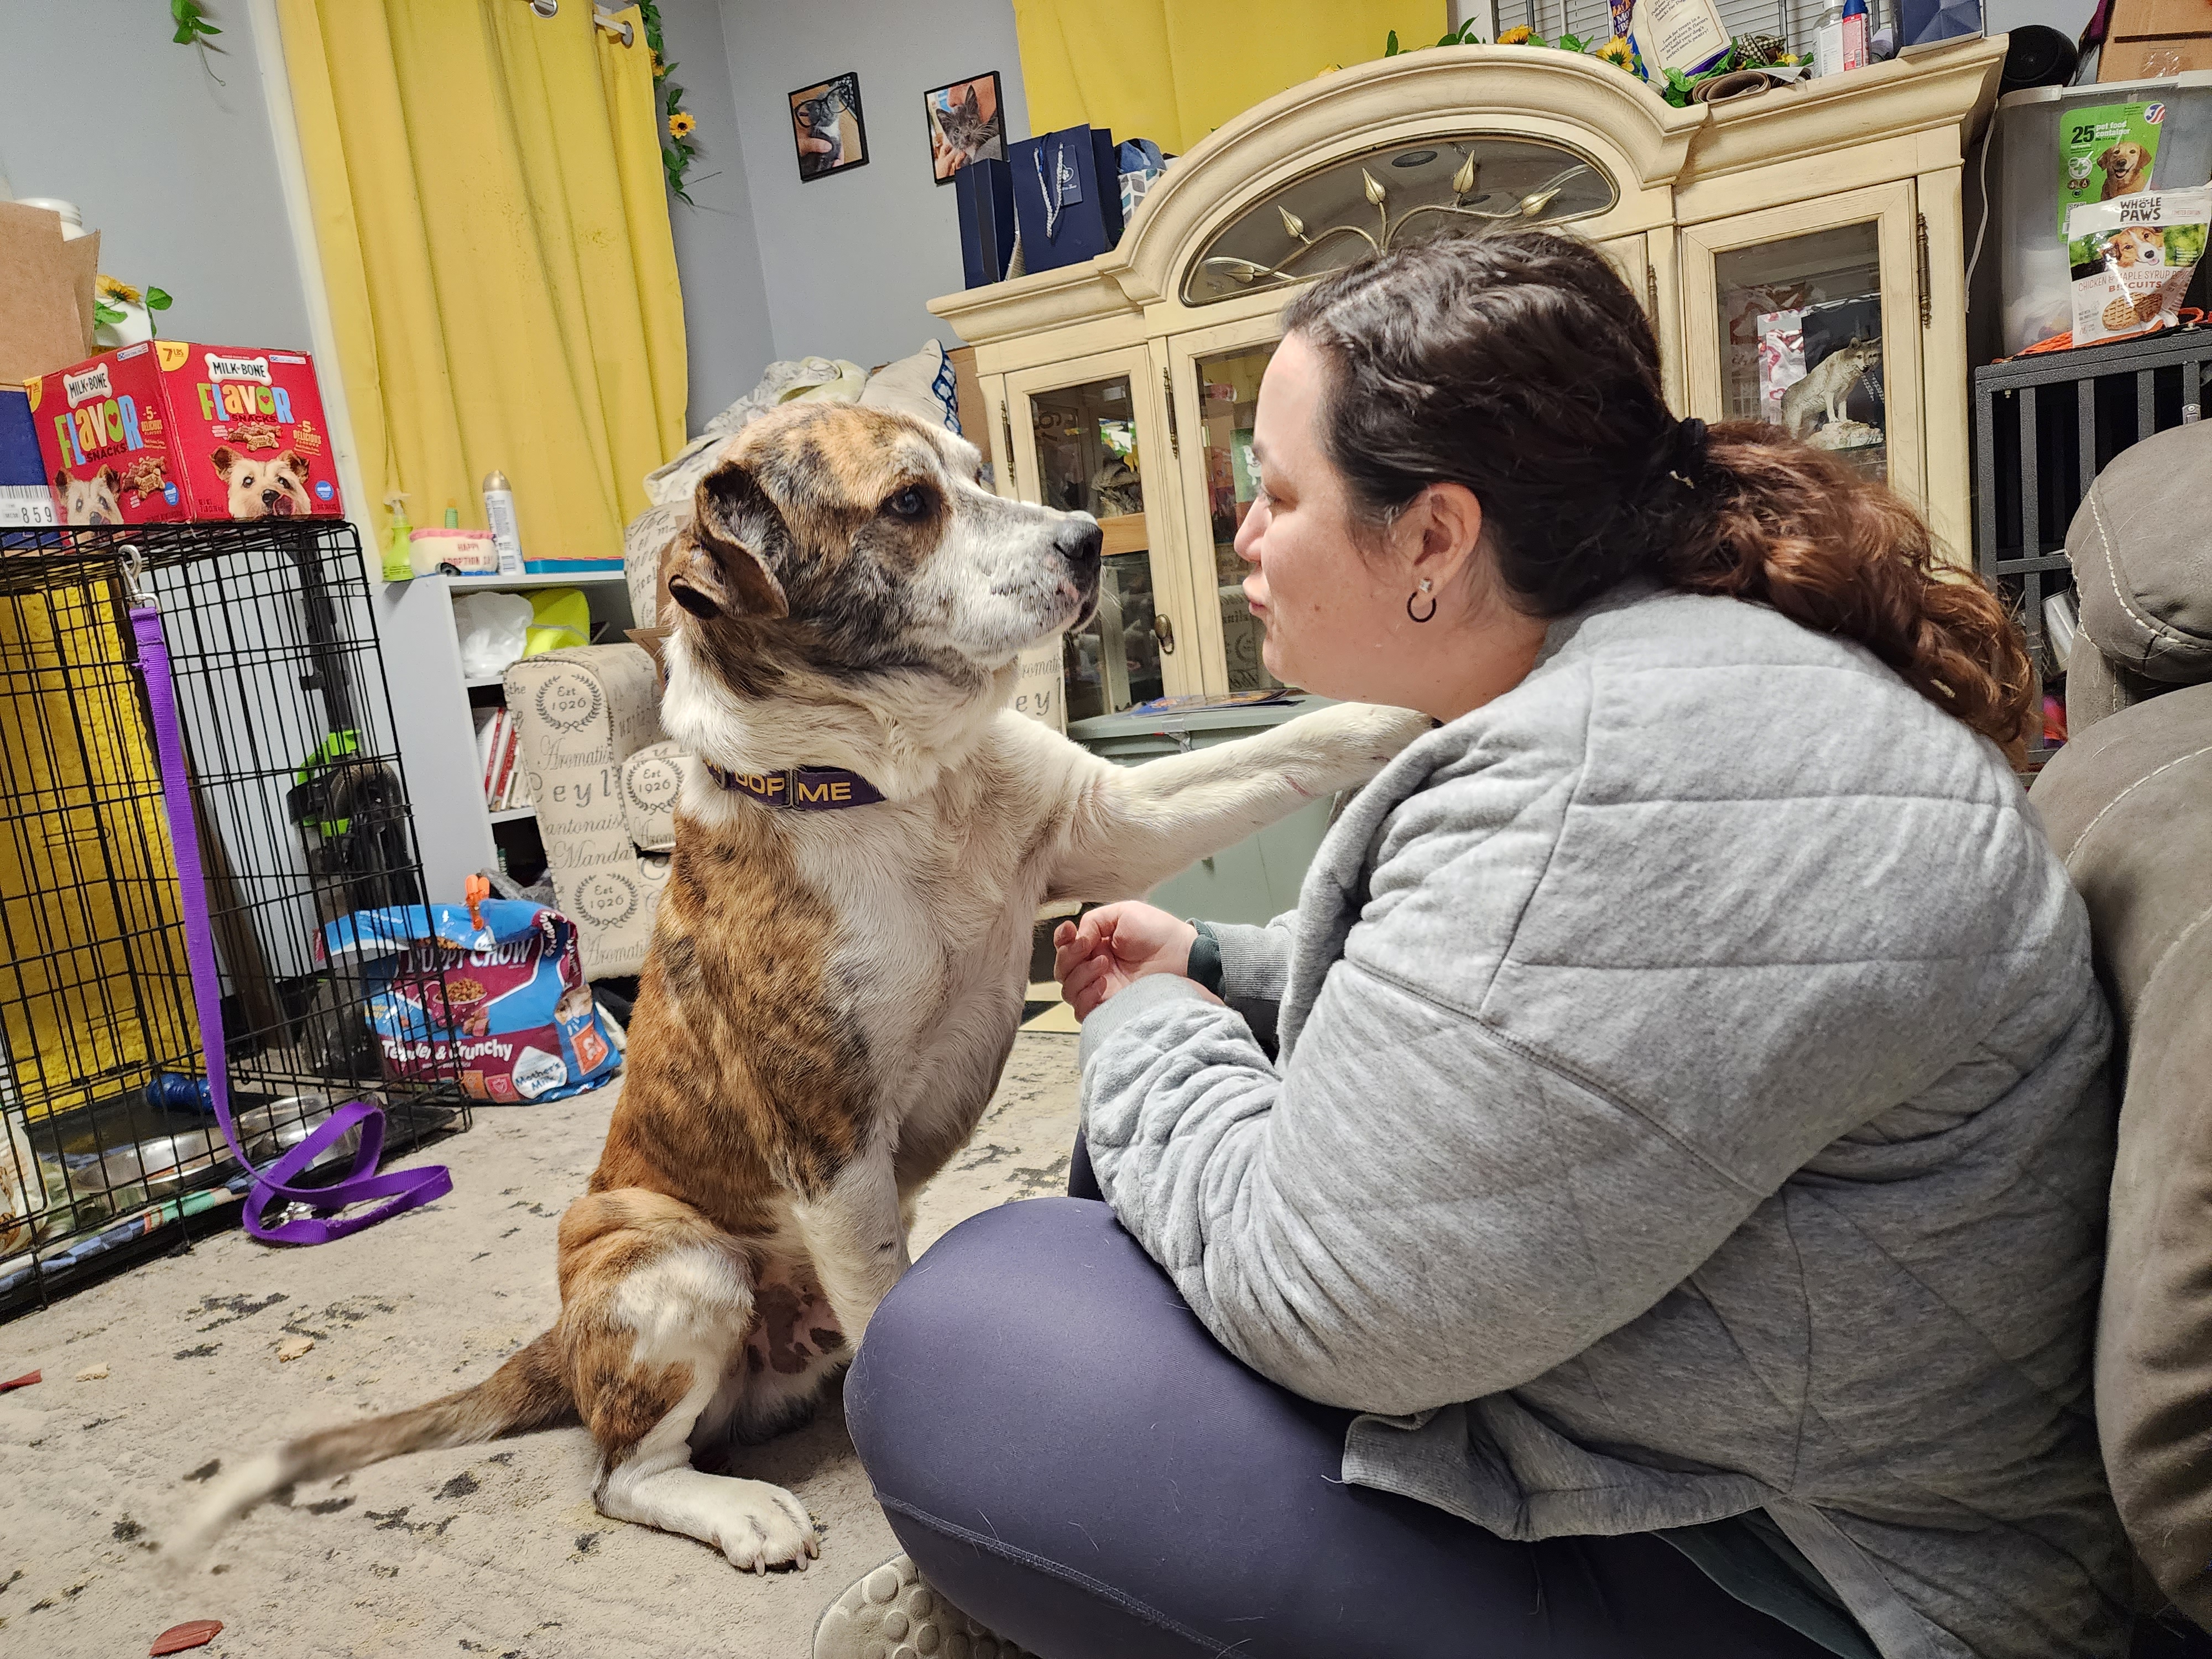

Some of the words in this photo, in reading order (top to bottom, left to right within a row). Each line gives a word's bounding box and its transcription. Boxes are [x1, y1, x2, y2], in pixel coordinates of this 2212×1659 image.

[1660, 41, 1672, 52] variety
[1677, 30, 1688, 38] sizes
[1692, 18, 1708, 28] flavors
[1662, 34, 1672, 44] Look
[1678, 22, 1691, 31] treats
[1671, 39, 1682, 50] build
[1682, 33, 1692, 42] your
[1666, 48, 1679, 61] perfect
[1679, 39, 1692, 49] snack
[2070, 125, 2095, 144] 25
[2096, 129, 2131, 137] container
[2120, 196, 2162, 209] WHOLE
[2120, 207, 2162, 222] PAWS
[2079, 276, 2107, 291] CHICKEN
[2144, 270, 2170, 280] SYRUP
[163, 348, 173, 362] 7
[232, 414, 277, 423] SNACKS
[293, 429, 322, 445] DELICIOUS
[86, 443, 128, 463] SNACKS
[1016, 676, 1061, 716] eyl
[552, 698, 587, 712] 1926
[639, 779, 671, 794] 1926
[799, 782, 852, 802] ME
[590, 895, 624, 910] 1926
[470, 938, 534, 967] CHOW
[435, 1045, 447, 1060] &
